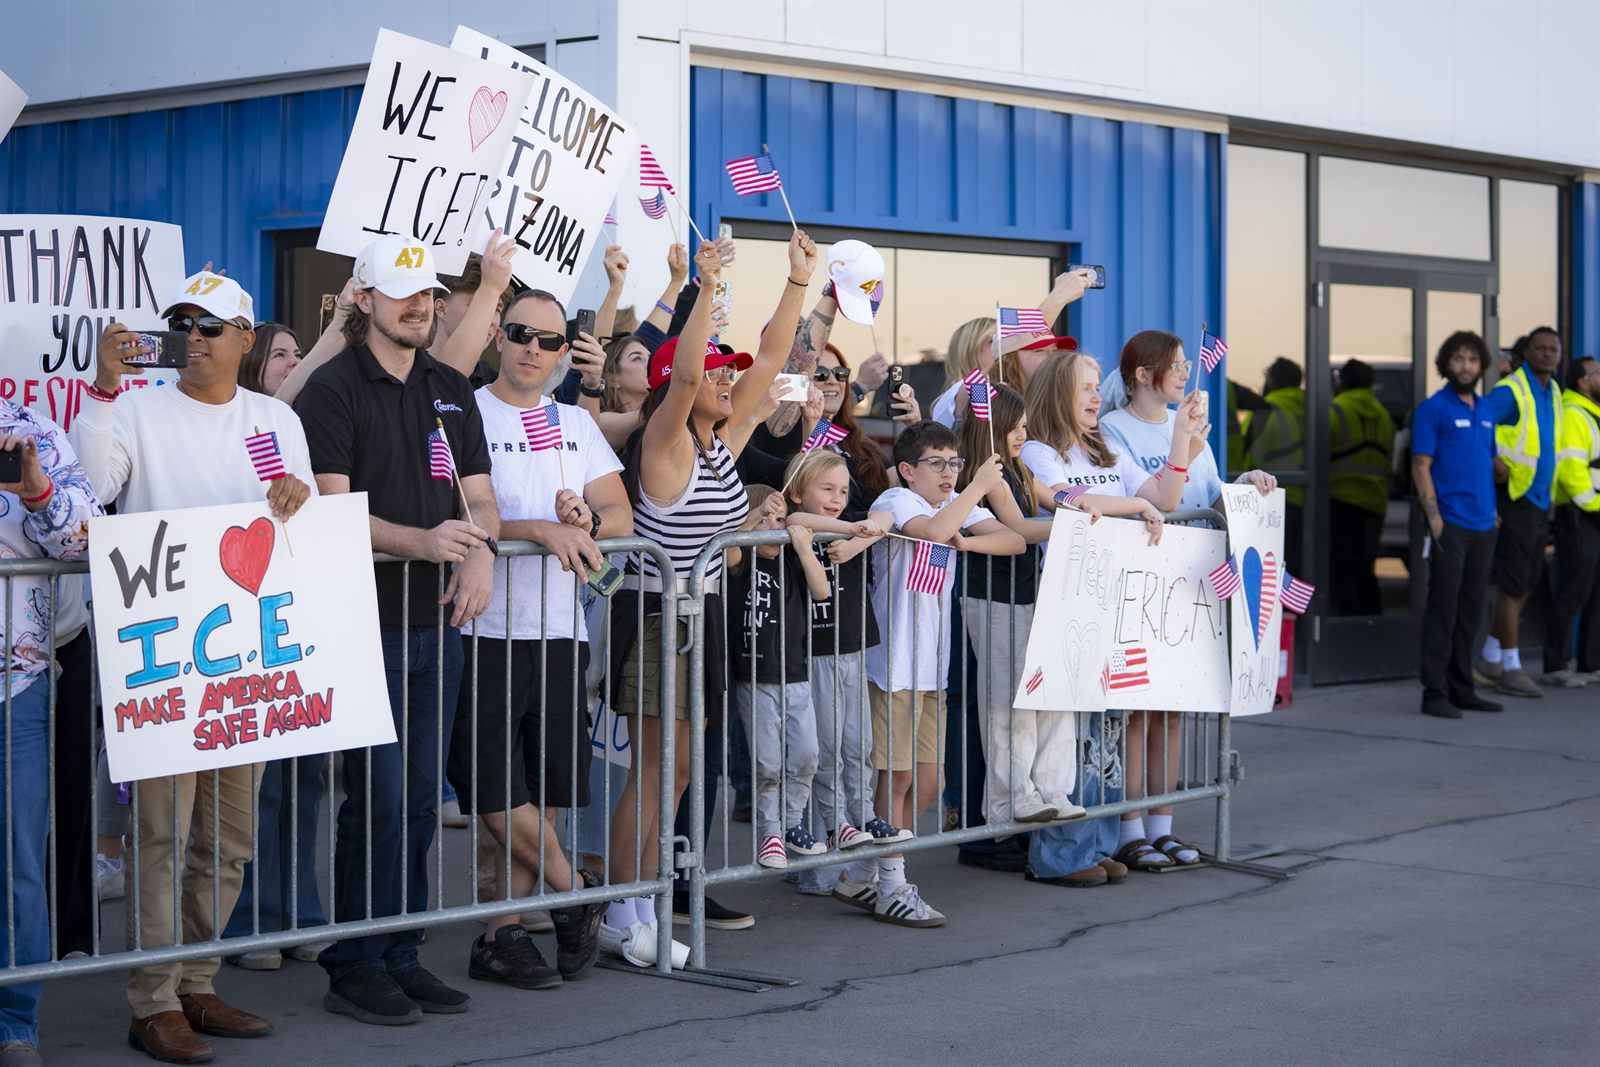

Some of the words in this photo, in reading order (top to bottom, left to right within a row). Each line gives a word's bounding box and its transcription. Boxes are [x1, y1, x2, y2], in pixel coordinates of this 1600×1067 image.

[382, 61, 456, 141] WE
[481, 47, 626, 175] LCOME
[506, 135, 553, 193] TO
[362, 155, 489, 247] ICE!
[484, 179, 586, 276] RIZONA
[0, 225, 159, 316] THANK
[185, 277, 225, 296] 47
[394, 247, 425, 269] 47
[490, 441, 578, 453] FREOM
[108, 519, 187, 609] WE
[117, 591, 316, 690] I.C.E.
[812, 602, 831, 620] IT
[114, 686, 186, 733] MAKE
[198, 669, 304, 718] AMERICA
[193, 708, 259, 751] SAFE
[263, 687, 335, 738] AGAIN
